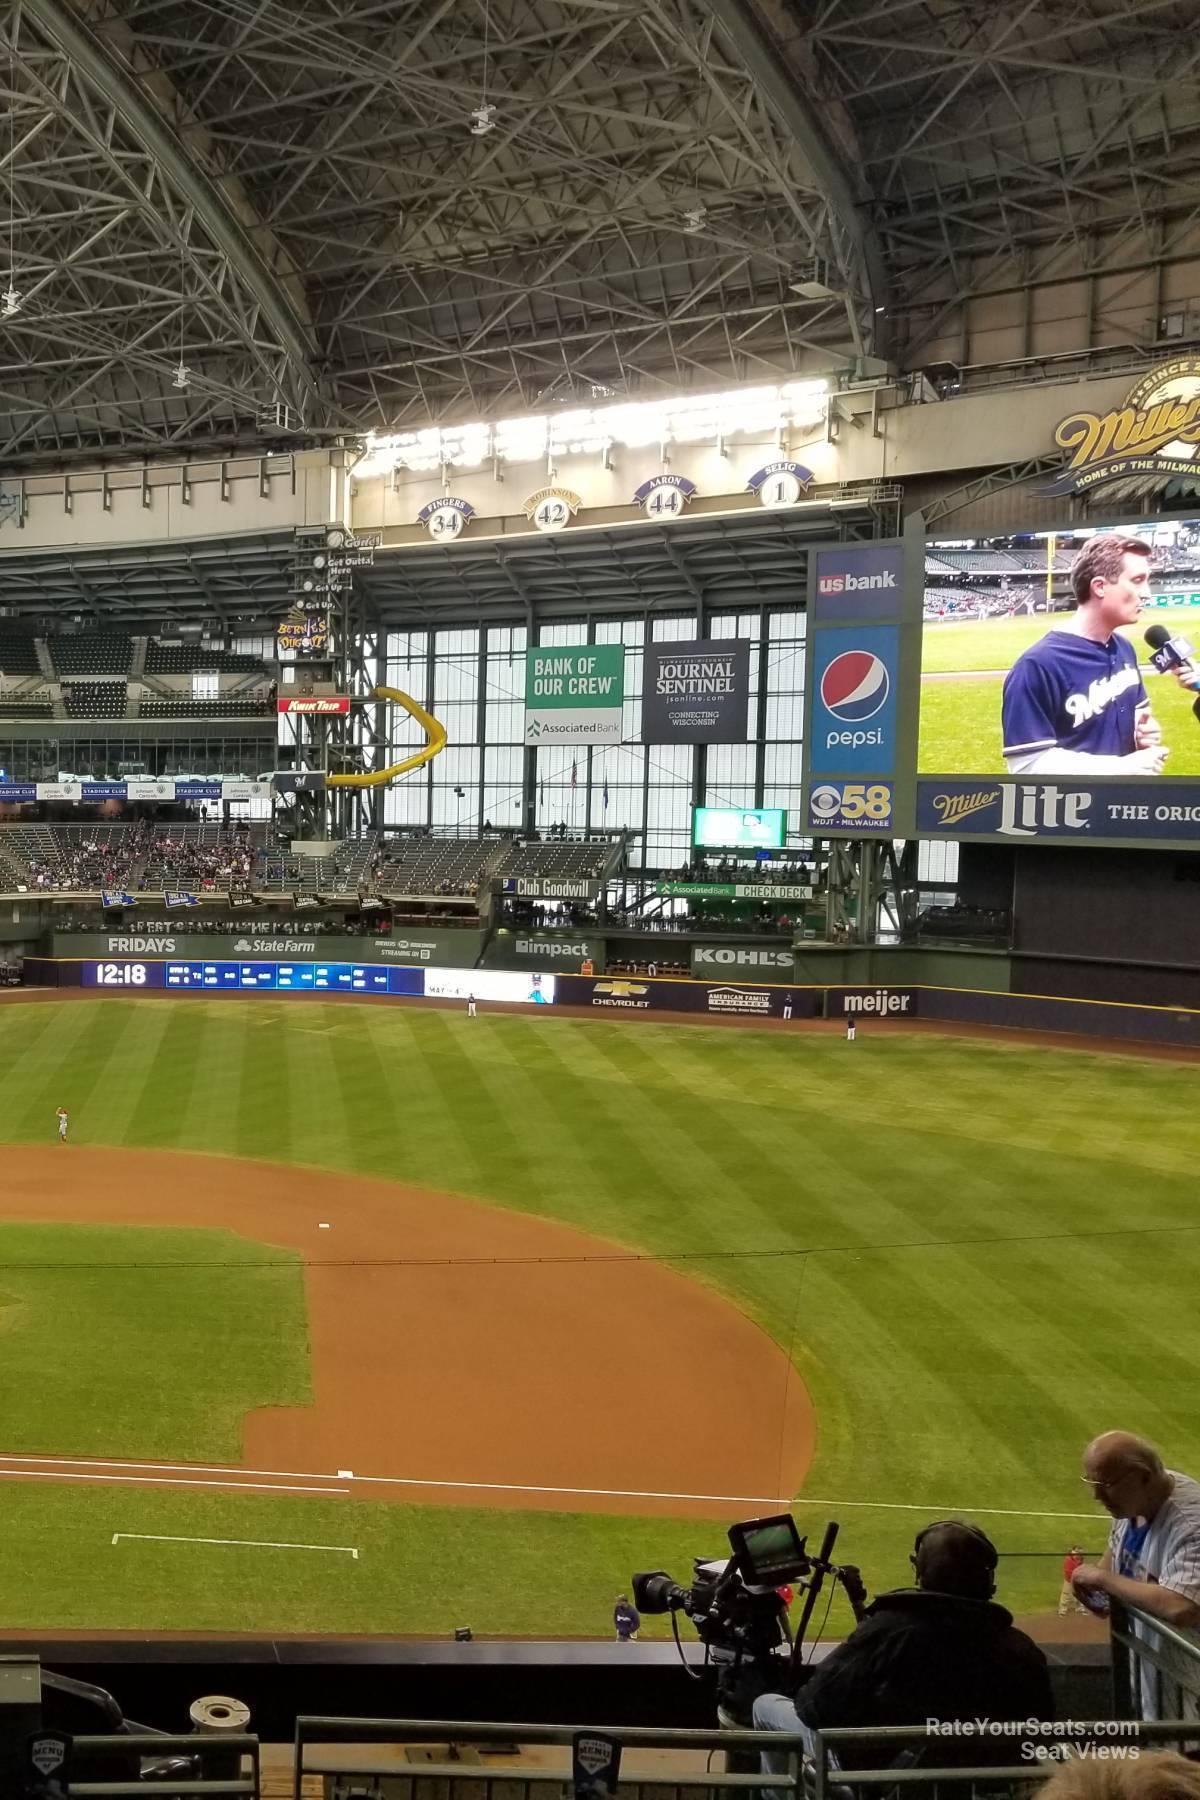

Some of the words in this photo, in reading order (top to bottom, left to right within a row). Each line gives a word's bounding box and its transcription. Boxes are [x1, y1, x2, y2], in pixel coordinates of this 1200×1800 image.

[1143, 362, 1189, 390] SINCE
[765, 461, 797, 475] SELIG
[1075, 468, 1108, 488] HOME
[1110, 463, 1127, 473] OF
[1130, 461, 1154, 470] THE
[649, 475, 682, 490] AARON
[776, 481, 787, 502] 1
[427, 499, 467, 513] FINGERS
[649, 492, 678, 513] 44
[433, 512, 459, 533] 34
[538, 505, 566, 524] 42
[327, 559, 343, 567] Get
[330, 567, 352, 575] Here
[534, 658, 573, 676] BANK
[578, 657, 597, 674] OF
[657, 662, 736, 681] JOURNAL
[534, 678, 563, 696] OUR
[656, 678, 735, 695] SENTINEL
[668, 711, 720, 720] CONNECTING
[840, 785, 892, 819] 58
[932, 790, 1000, 825] Miller
[996, 783, 1092, 836] Lite
[1108, 804, 1149, 820] THE
[812, 818, 834, 826] WDJT
[841, 818, 889, 827] MILWAUKEE
[517, 878, 540, 896] Club
[543, 878, 589, 897] Goodwill
[743, 885, 777, 897] CHECK
[779, 886, 806, 898] DECK
[108, 937, 176, 952] FRIDAYS
[528, 938, 589, 957] impact
[694, 948, 794, 967] KOHL'S
[97, 964, 146, 984] 12:18
[592, 998, 650, 1008] CHEVROLET
[708, 993, 744, 1001] AMERICAN
[745, 994, 770, 1002] FAMILY
[844, 990, 910, 1016] meijer
[33, 1746, 64, 1757] MENU
